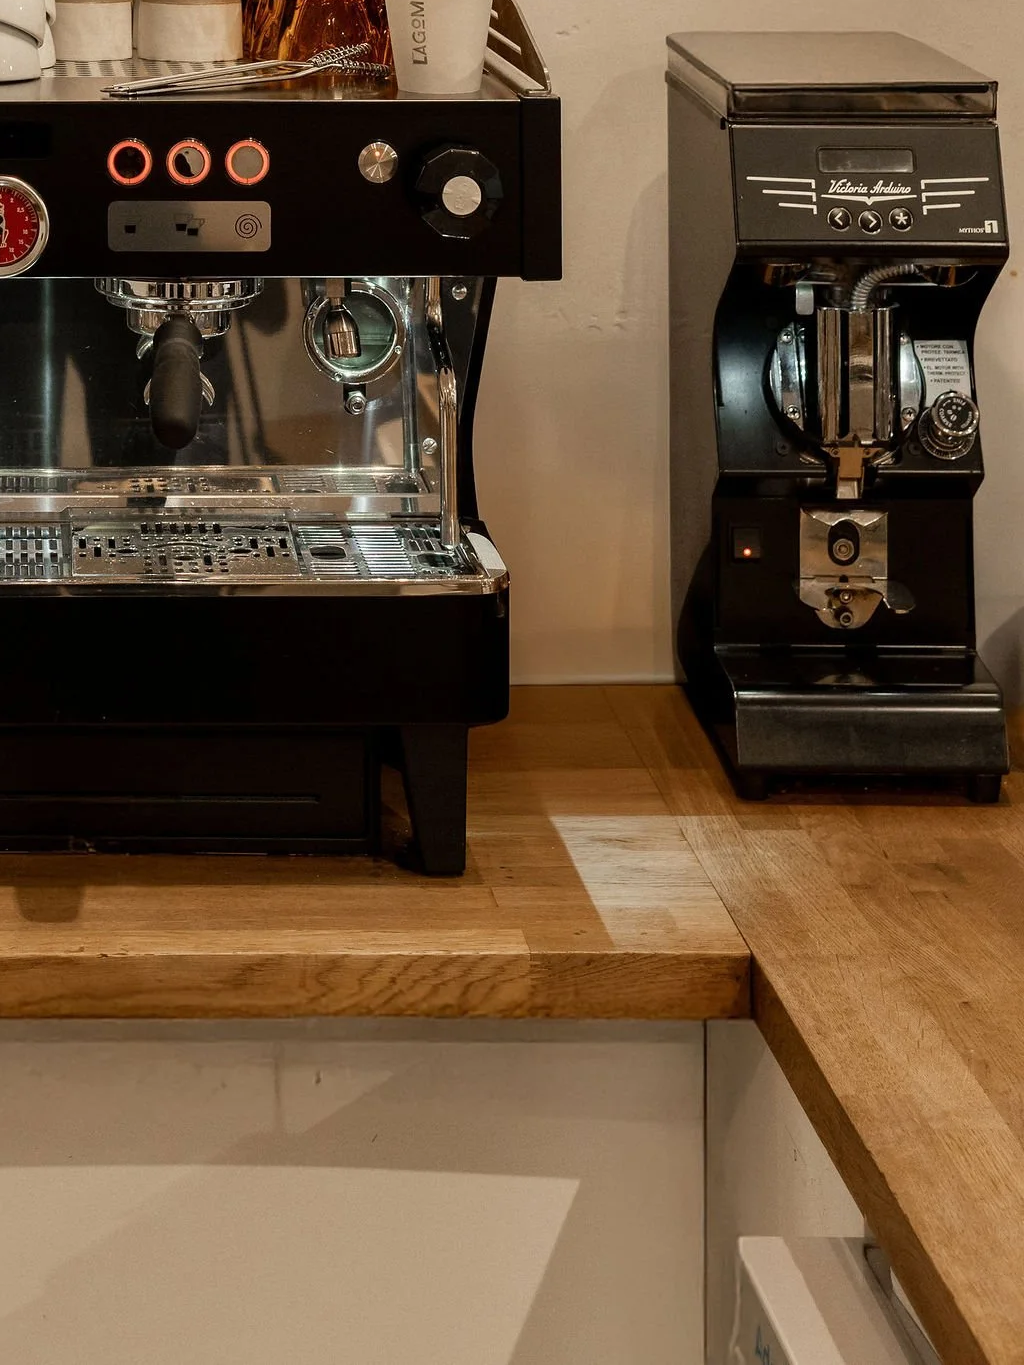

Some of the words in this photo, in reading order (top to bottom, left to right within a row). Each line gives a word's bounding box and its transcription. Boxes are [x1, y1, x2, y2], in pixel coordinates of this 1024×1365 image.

[410, 0, 428, 65] LAGOM
[828, 179, 868, 193] Victoria
[869, 179, 911, 194] Arduino
